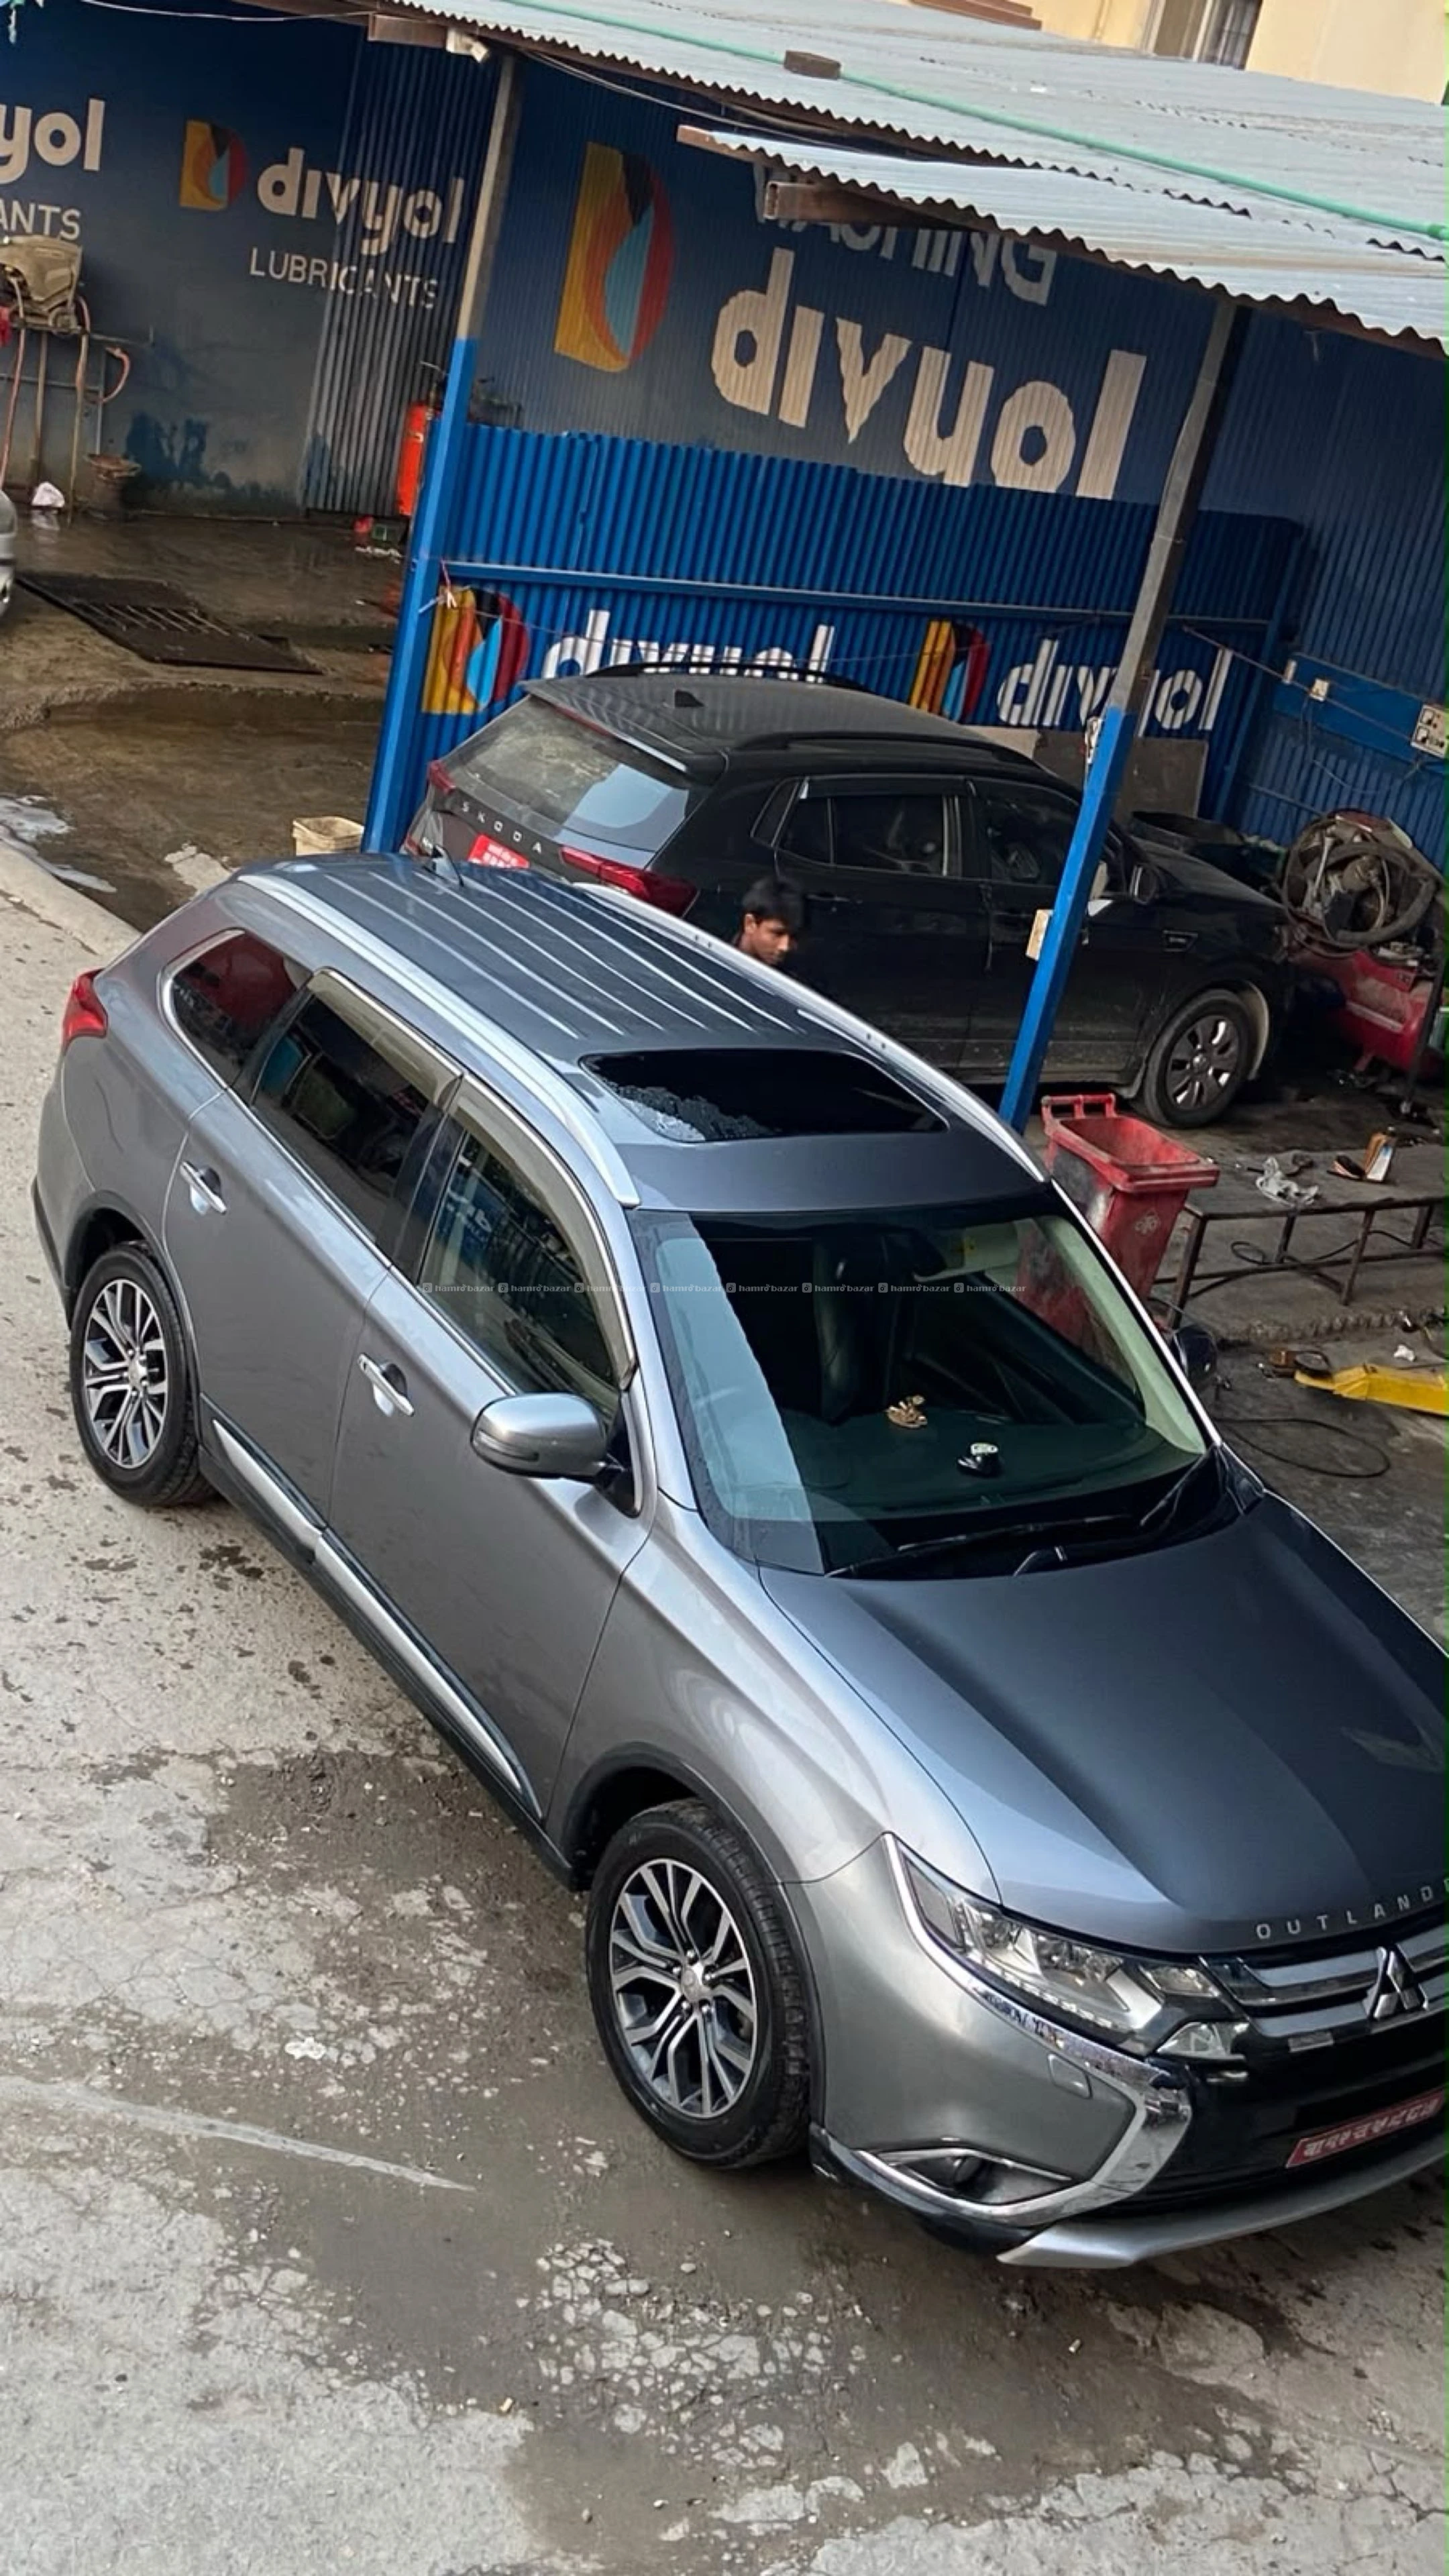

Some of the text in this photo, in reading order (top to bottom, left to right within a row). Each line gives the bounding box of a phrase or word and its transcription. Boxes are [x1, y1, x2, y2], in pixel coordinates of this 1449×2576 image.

[250, 248, 438, 309] LUBRICANTS
[996, 639, 1233, 738] divol
[462, 801, 542, 854] SKODA
